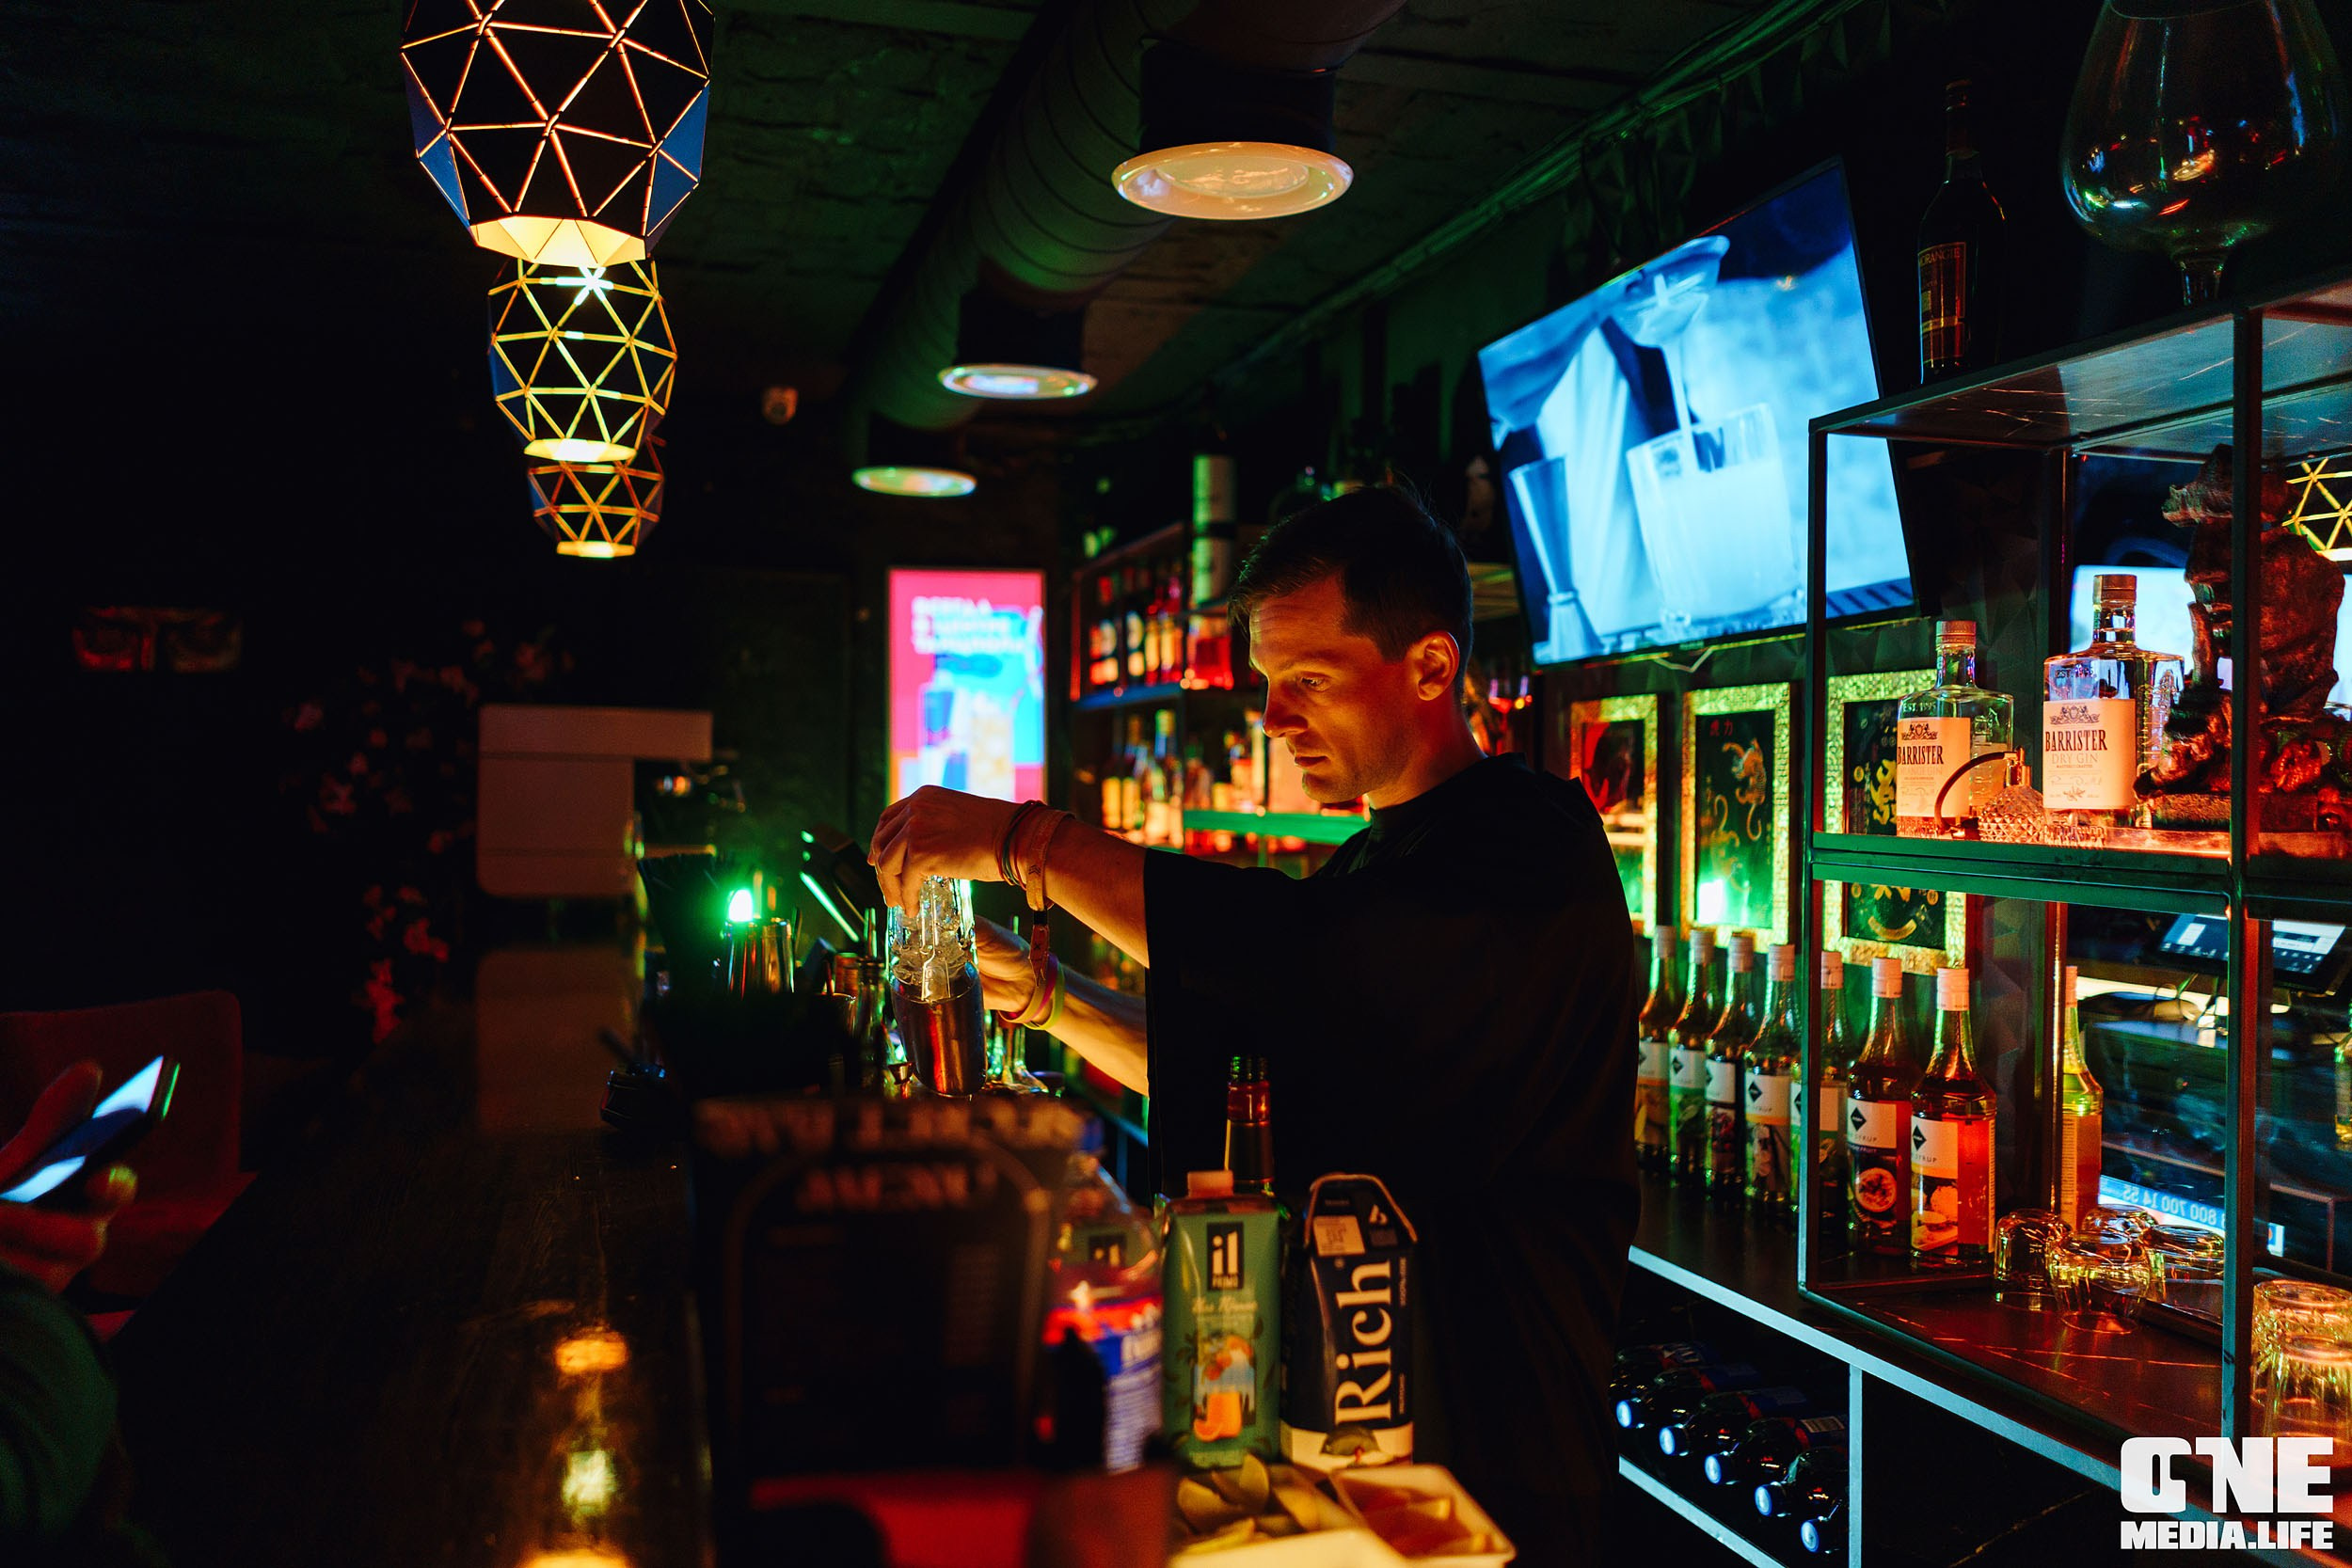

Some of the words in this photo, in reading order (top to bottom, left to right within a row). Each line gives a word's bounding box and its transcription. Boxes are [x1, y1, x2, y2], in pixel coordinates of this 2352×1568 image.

[2045, 730, 2107, 752] BARRISTER
[1898, 746, 1944, 765] BARRISTER
[2052, 753, 2074, 764] DRY
[2076, 752, 2098, 764] GIN
[1335, 1259, 1392, 1425] Rich
